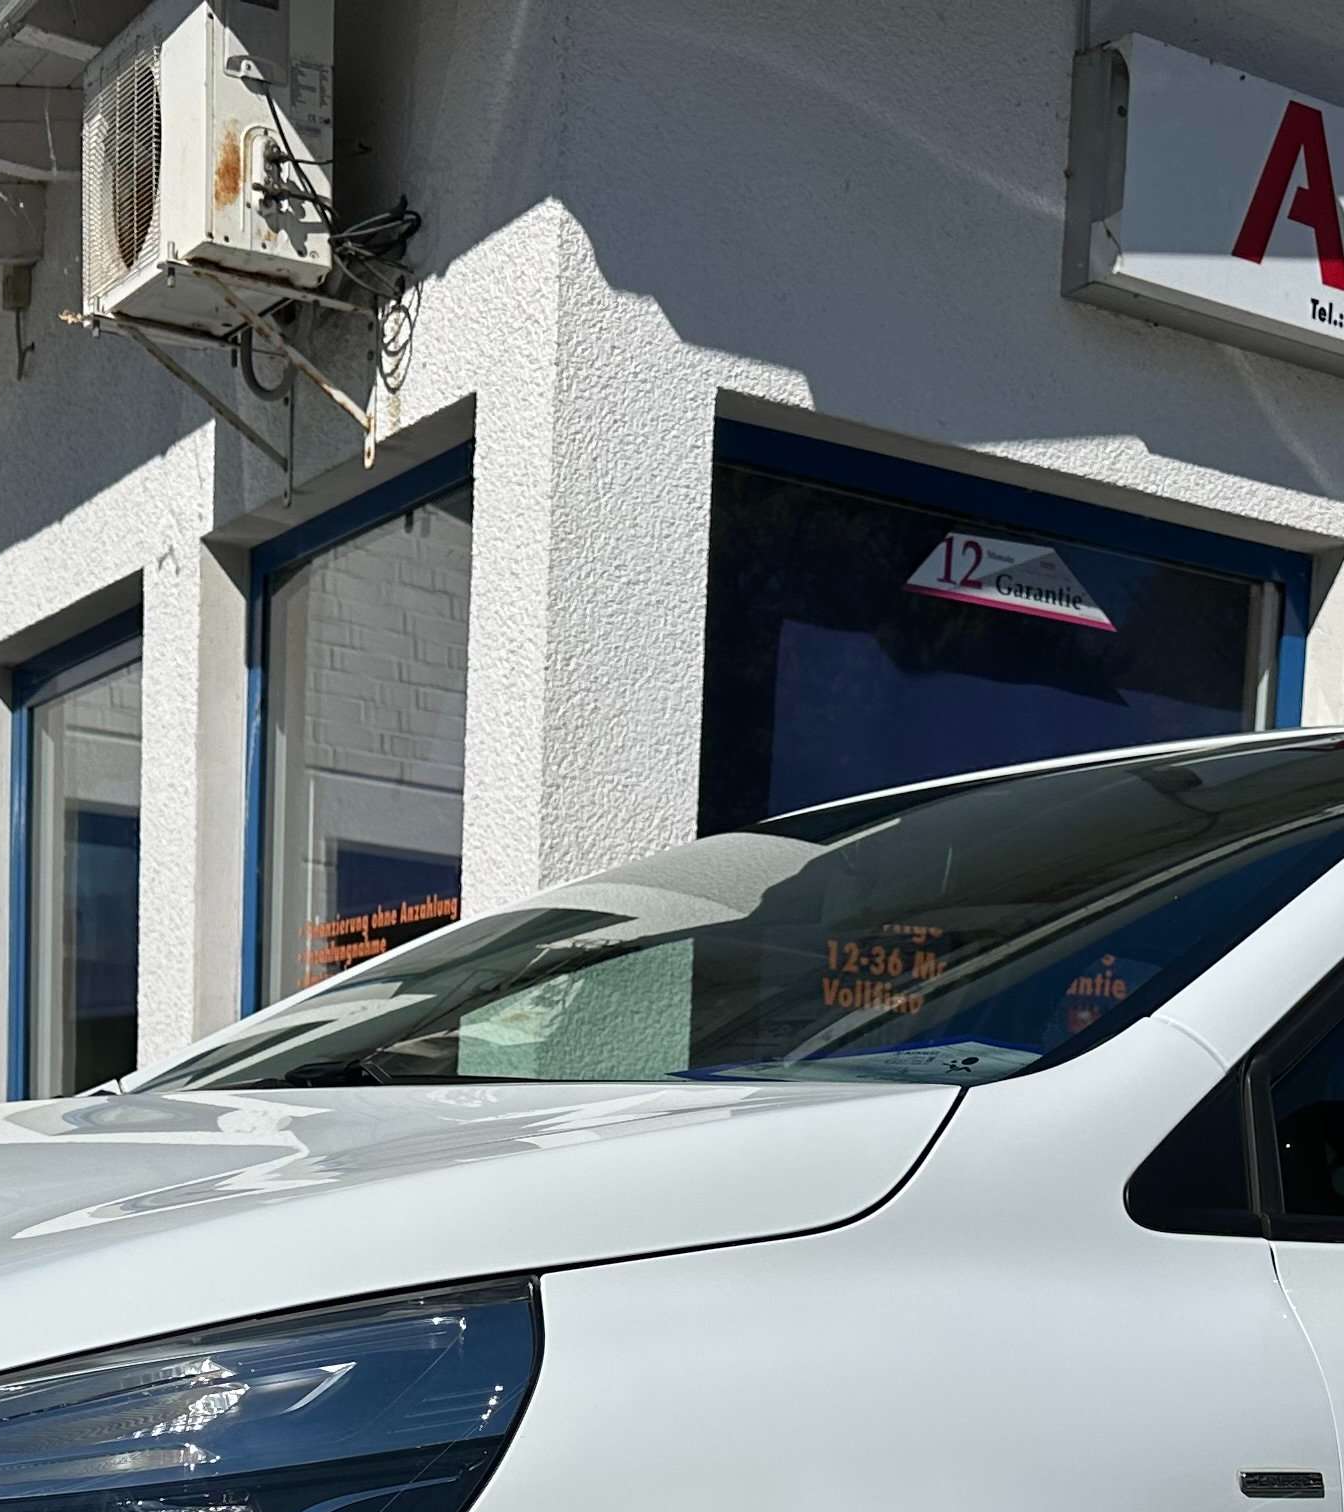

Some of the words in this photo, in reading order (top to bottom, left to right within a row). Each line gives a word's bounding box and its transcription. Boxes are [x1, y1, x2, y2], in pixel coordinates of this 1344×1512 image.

[1310, 297, 1344, 328] Tel.:
[936, 535, 984, 590] 12
[995, 574, 1083, 610] Garantie
[371, 904, 397, 928] ohne
[400, 895, 458, 922] Anzahlung
[826, 939, 903, 977] 12-36
